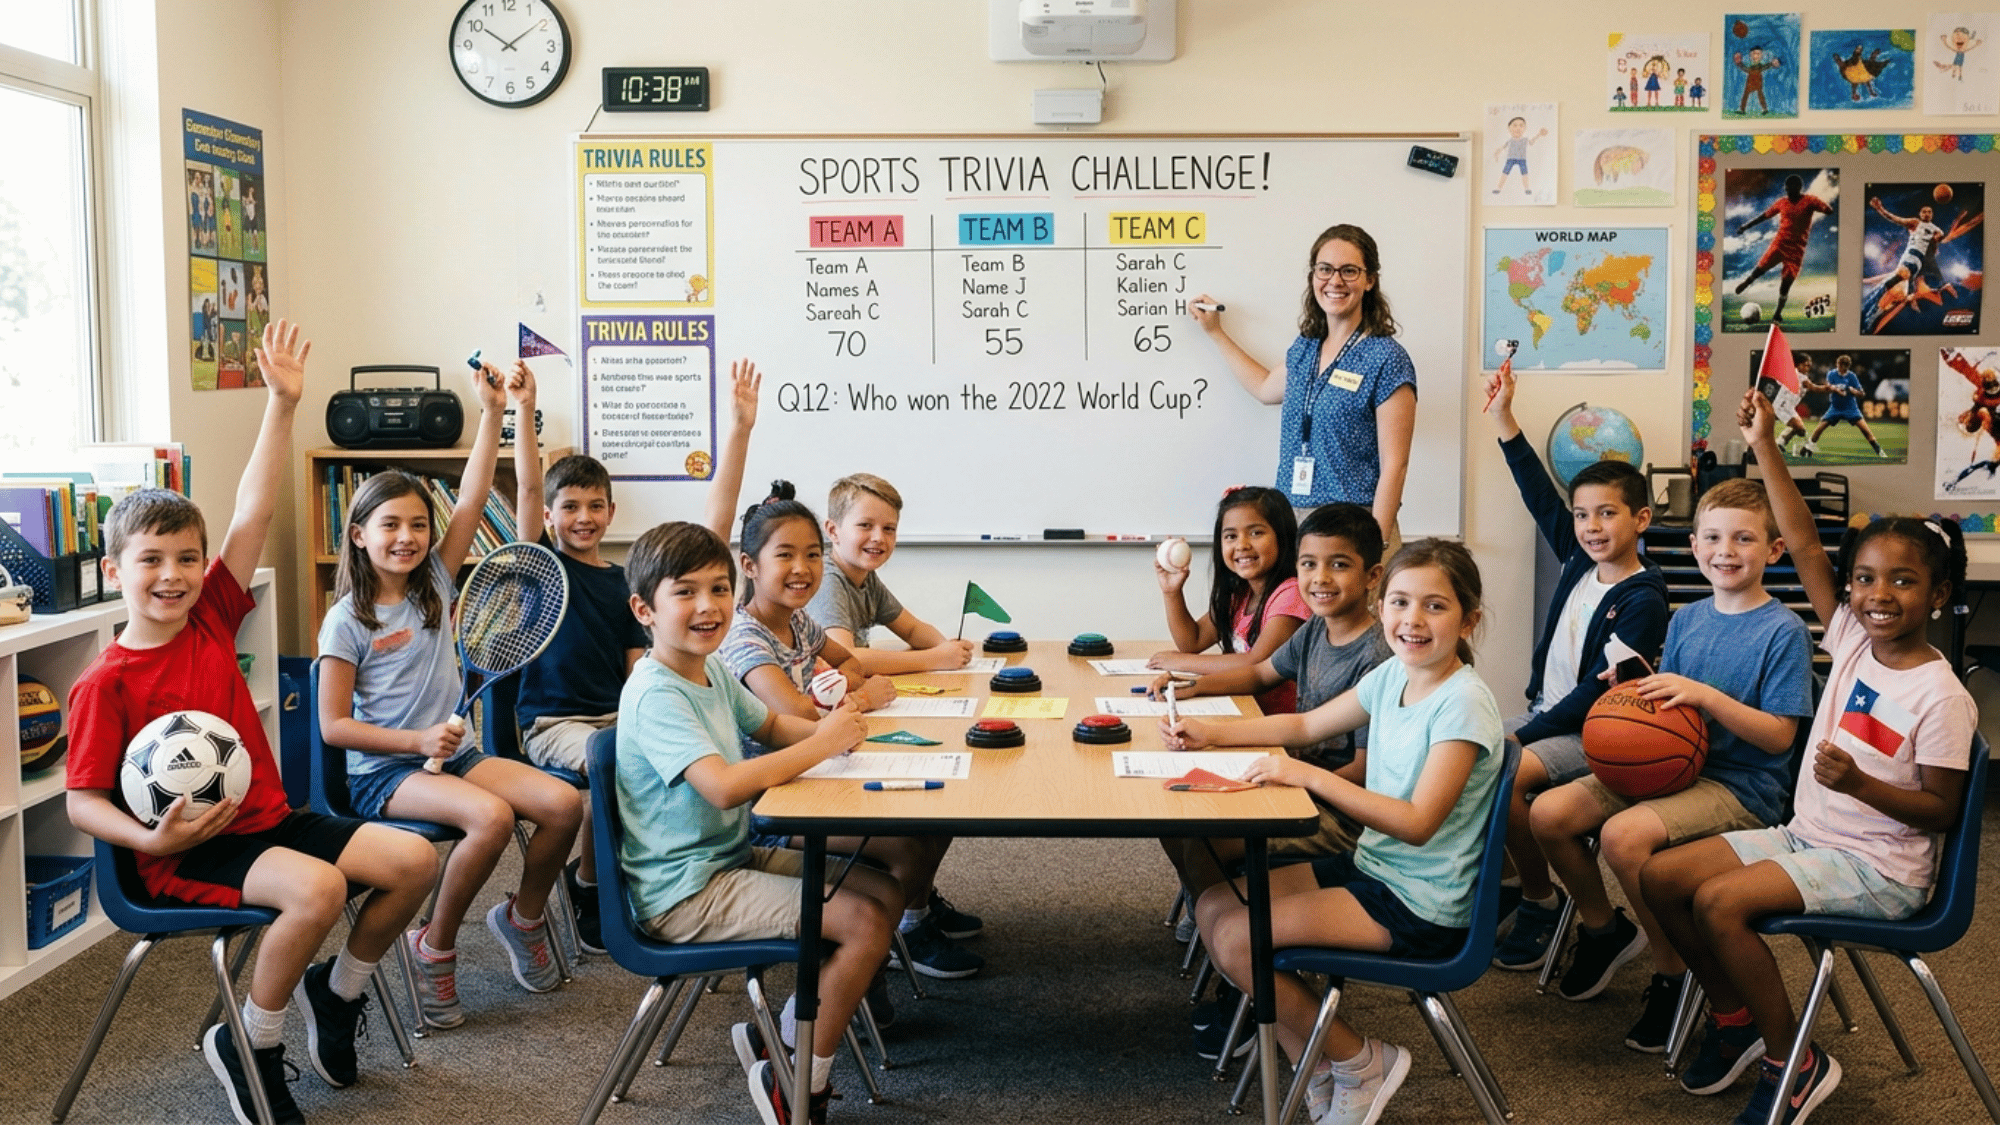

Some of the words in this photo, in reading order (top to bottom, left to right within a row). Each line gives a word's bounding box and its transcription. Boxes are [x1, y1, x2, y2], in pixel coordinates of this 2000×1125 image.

[483, 4, 493, 16] 11
[502, 0, 516, 11] 12
[527, 4, 531, 16] 1
[468, 19, 483, 32] 10
[539, 19, 547, 31] 2
[463, 40, 472, 50] 9
[547, 40, 556, 53] 3
[541, 61, 549, 73] 4
[485, 76, 494, 88] 7
[506, 82, 515, 94] 6
[526, 76, 535, 89] 5
[621, 76, 682, 103] 10:38
[583, 149, 644, 168] TRIVIA
[649, 149, 706, 168] RULES
[799, 156, 920, 195] SPORTS
[939, 156, 1049, 192] TRIVIA
[1072, 152, 1270, 191] CHALLENGE!
[815, 220, 873, 242] TEAM
[884, 220, 898, 242] A
[964, 218, 1023, 240] TEAM
[1034, 216, 1048, 240] B
[1113, 216, 1175, 239] TEAM
[1185, 216, 1200, 239] C
[1535, 231, 1584, 242] WORLD
[1587, 231, 1618, 242] MAP
[806, 258, 848, 275] Team
[856, 257, 868, 273] A
[962, 254, 1004, 272] Team
[1013, 254, 1025, 272] B
[1116, 253, 1165, 271] Sarah
[1174, 252, 1186, 270] C
[806, 281, 859, 297] Names
[866, 280, 879, 296] A
[963, 278, 1008, 295] Name
[1015, 277, 1026, 295] J
[1117, 277, 1167, 293] Kalien
[1175, 275, 1186, 293] J
[806, 303, 861, 321] Sareah
[868, 302, 879, 320] C
[963, 300, 1009, 318] Sarah
[1017, 300, 1028, 318] C
[1118, 299, 1167, 316] Sarian
[1175, 299, 1186, 315] H
[587, 321, 647, 341] TRIVIA
[652, 321, 709, 341] RULES
[1134, 325, 1172, 352] 65
[828, 331, 866, 357] 70
[986, 328, 1023, 355] 55
[778, 383, 837, 412] Q12:
[848, 383, 897, 411] Who
[907, 394, 949, 411] won
[960, 383, 997, 411] the
[1008, 381, 1066, 410] 2022
[1077, 382, 1139, 410] World
[1150, 378, 1208, 419] Cup?
